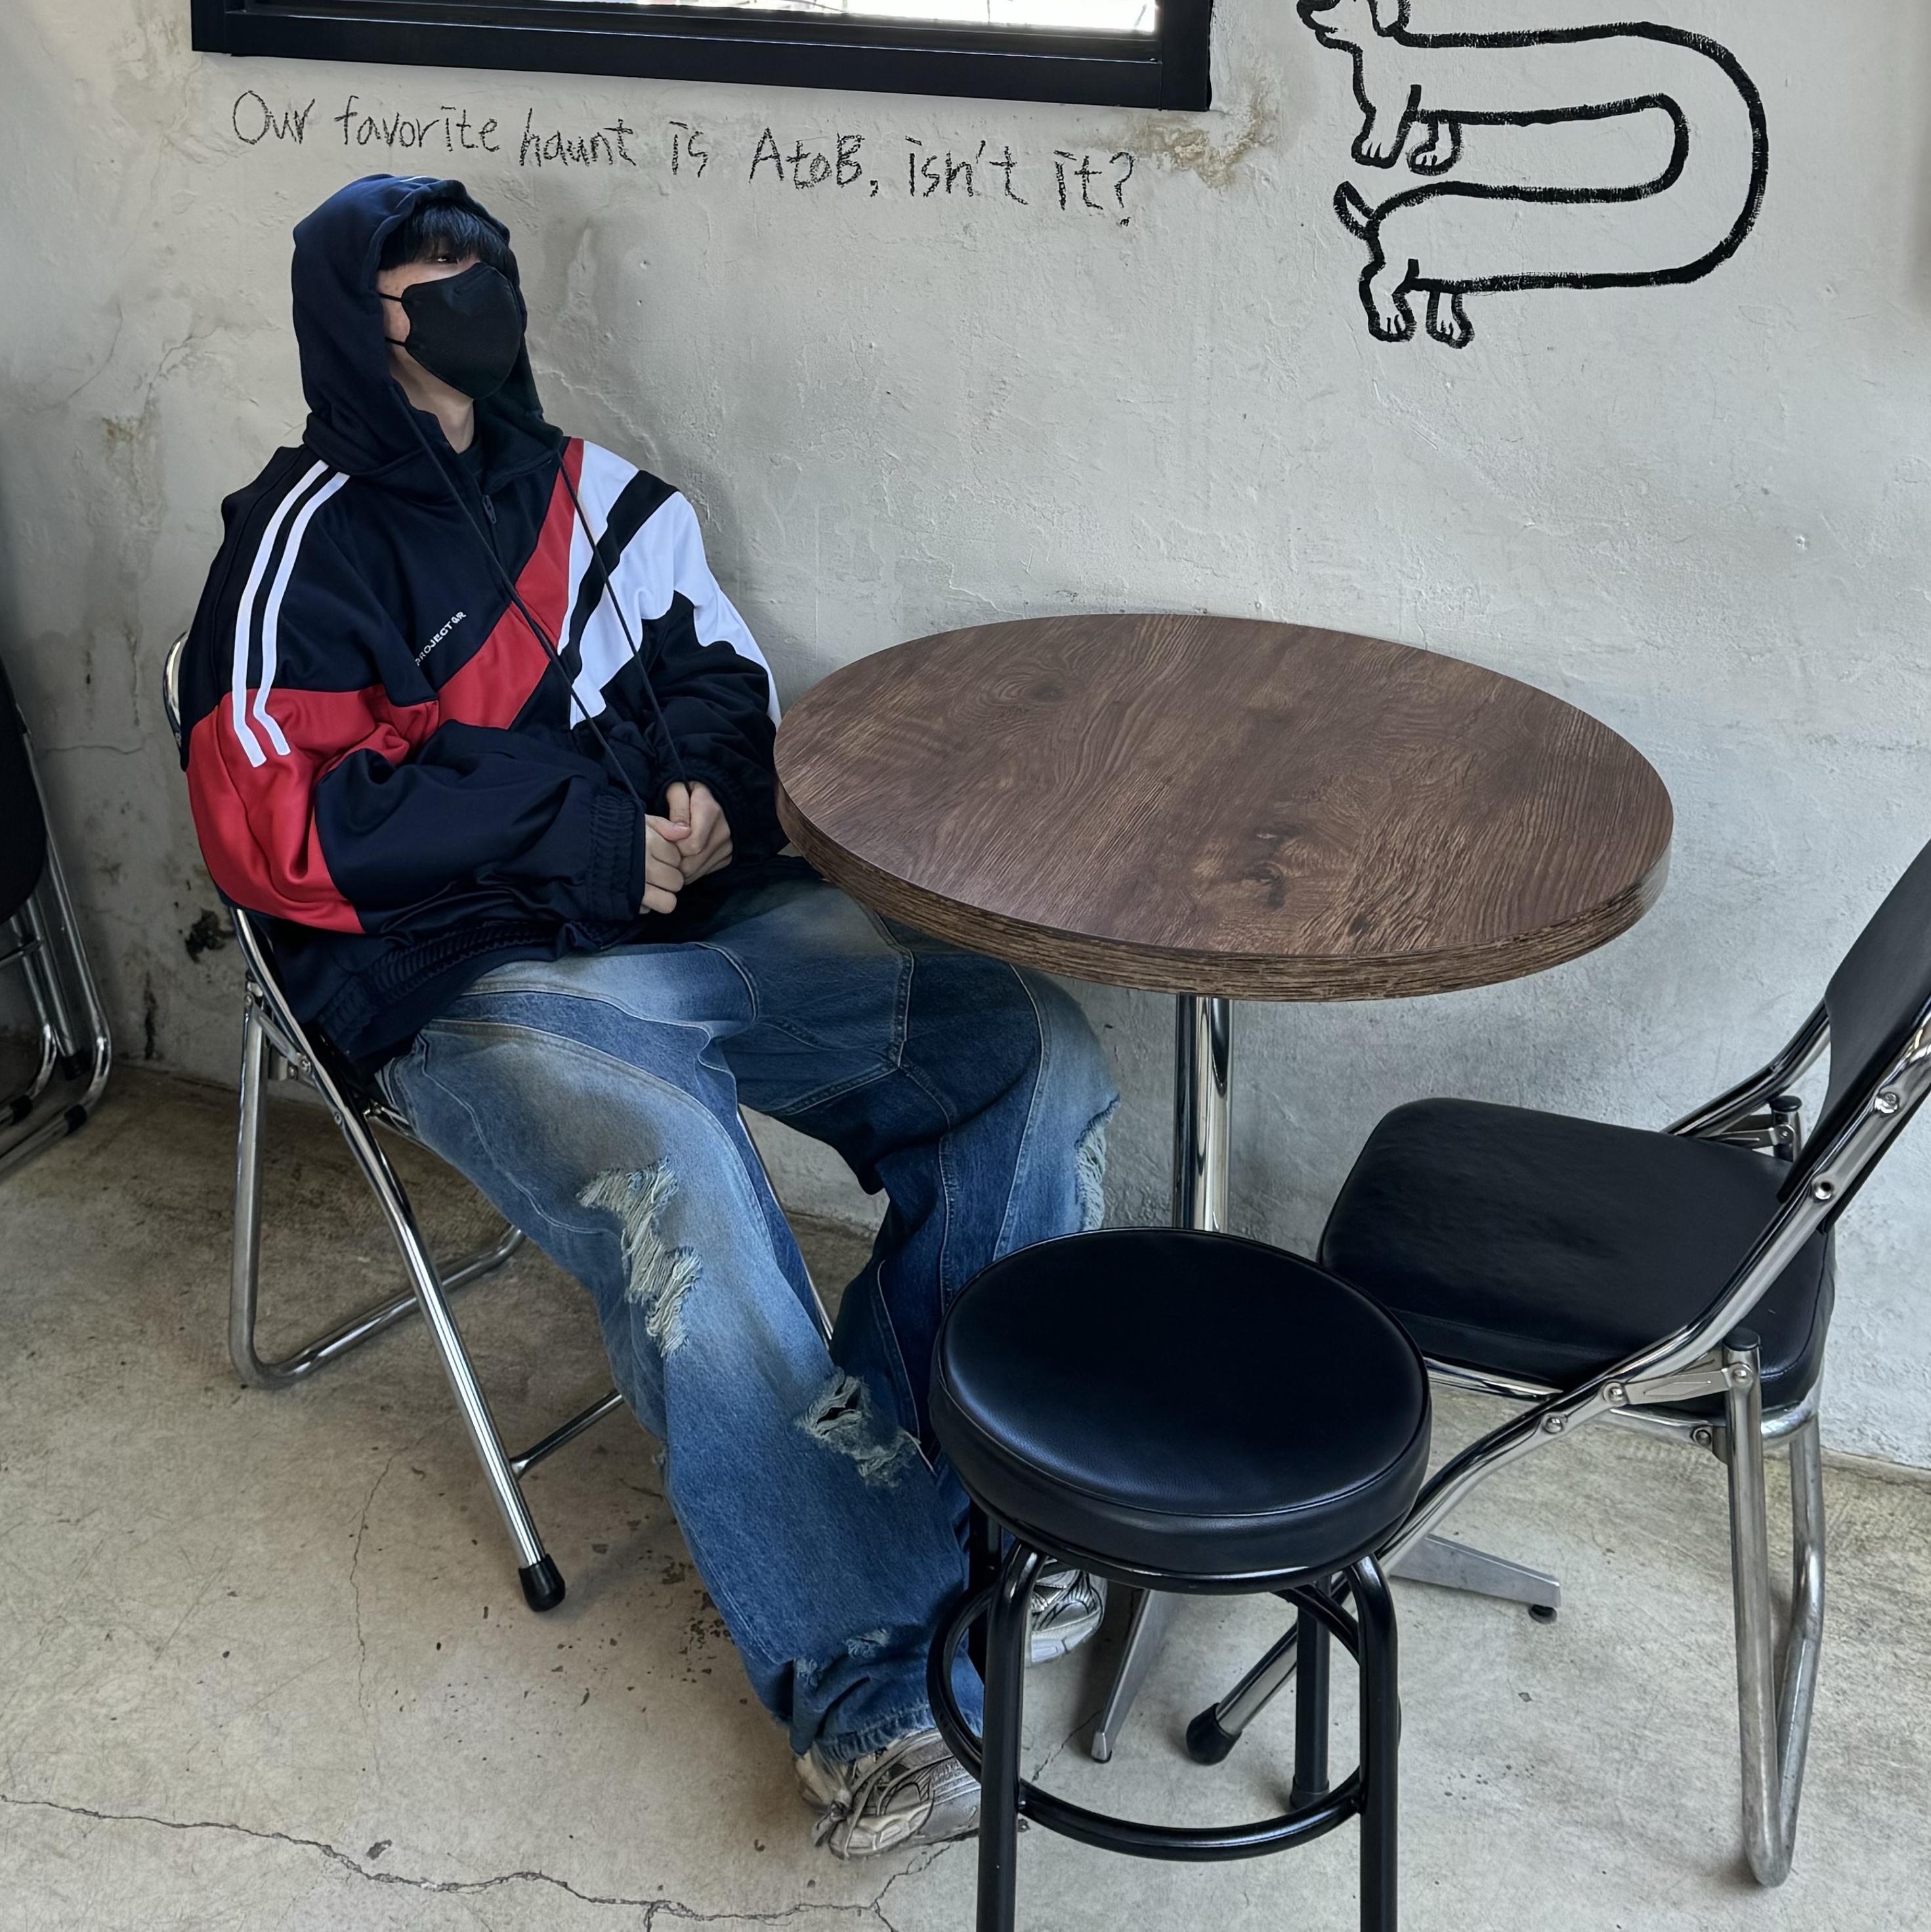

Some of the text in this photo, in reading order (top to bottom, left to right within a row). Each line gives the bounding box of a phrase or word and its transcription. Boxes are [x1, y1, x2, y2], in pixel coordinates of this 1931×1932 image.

[232, 90, 315, 145] Our
[333, 95, 501, 152] favorite
[519, 108, 637, 167] haunt
[669, 120, 709, 179] is
[904, 135, 1029, 205] isn't
[1053, 149, 1135, 227] it?
[415, 620, 453, 666] PROJECT
